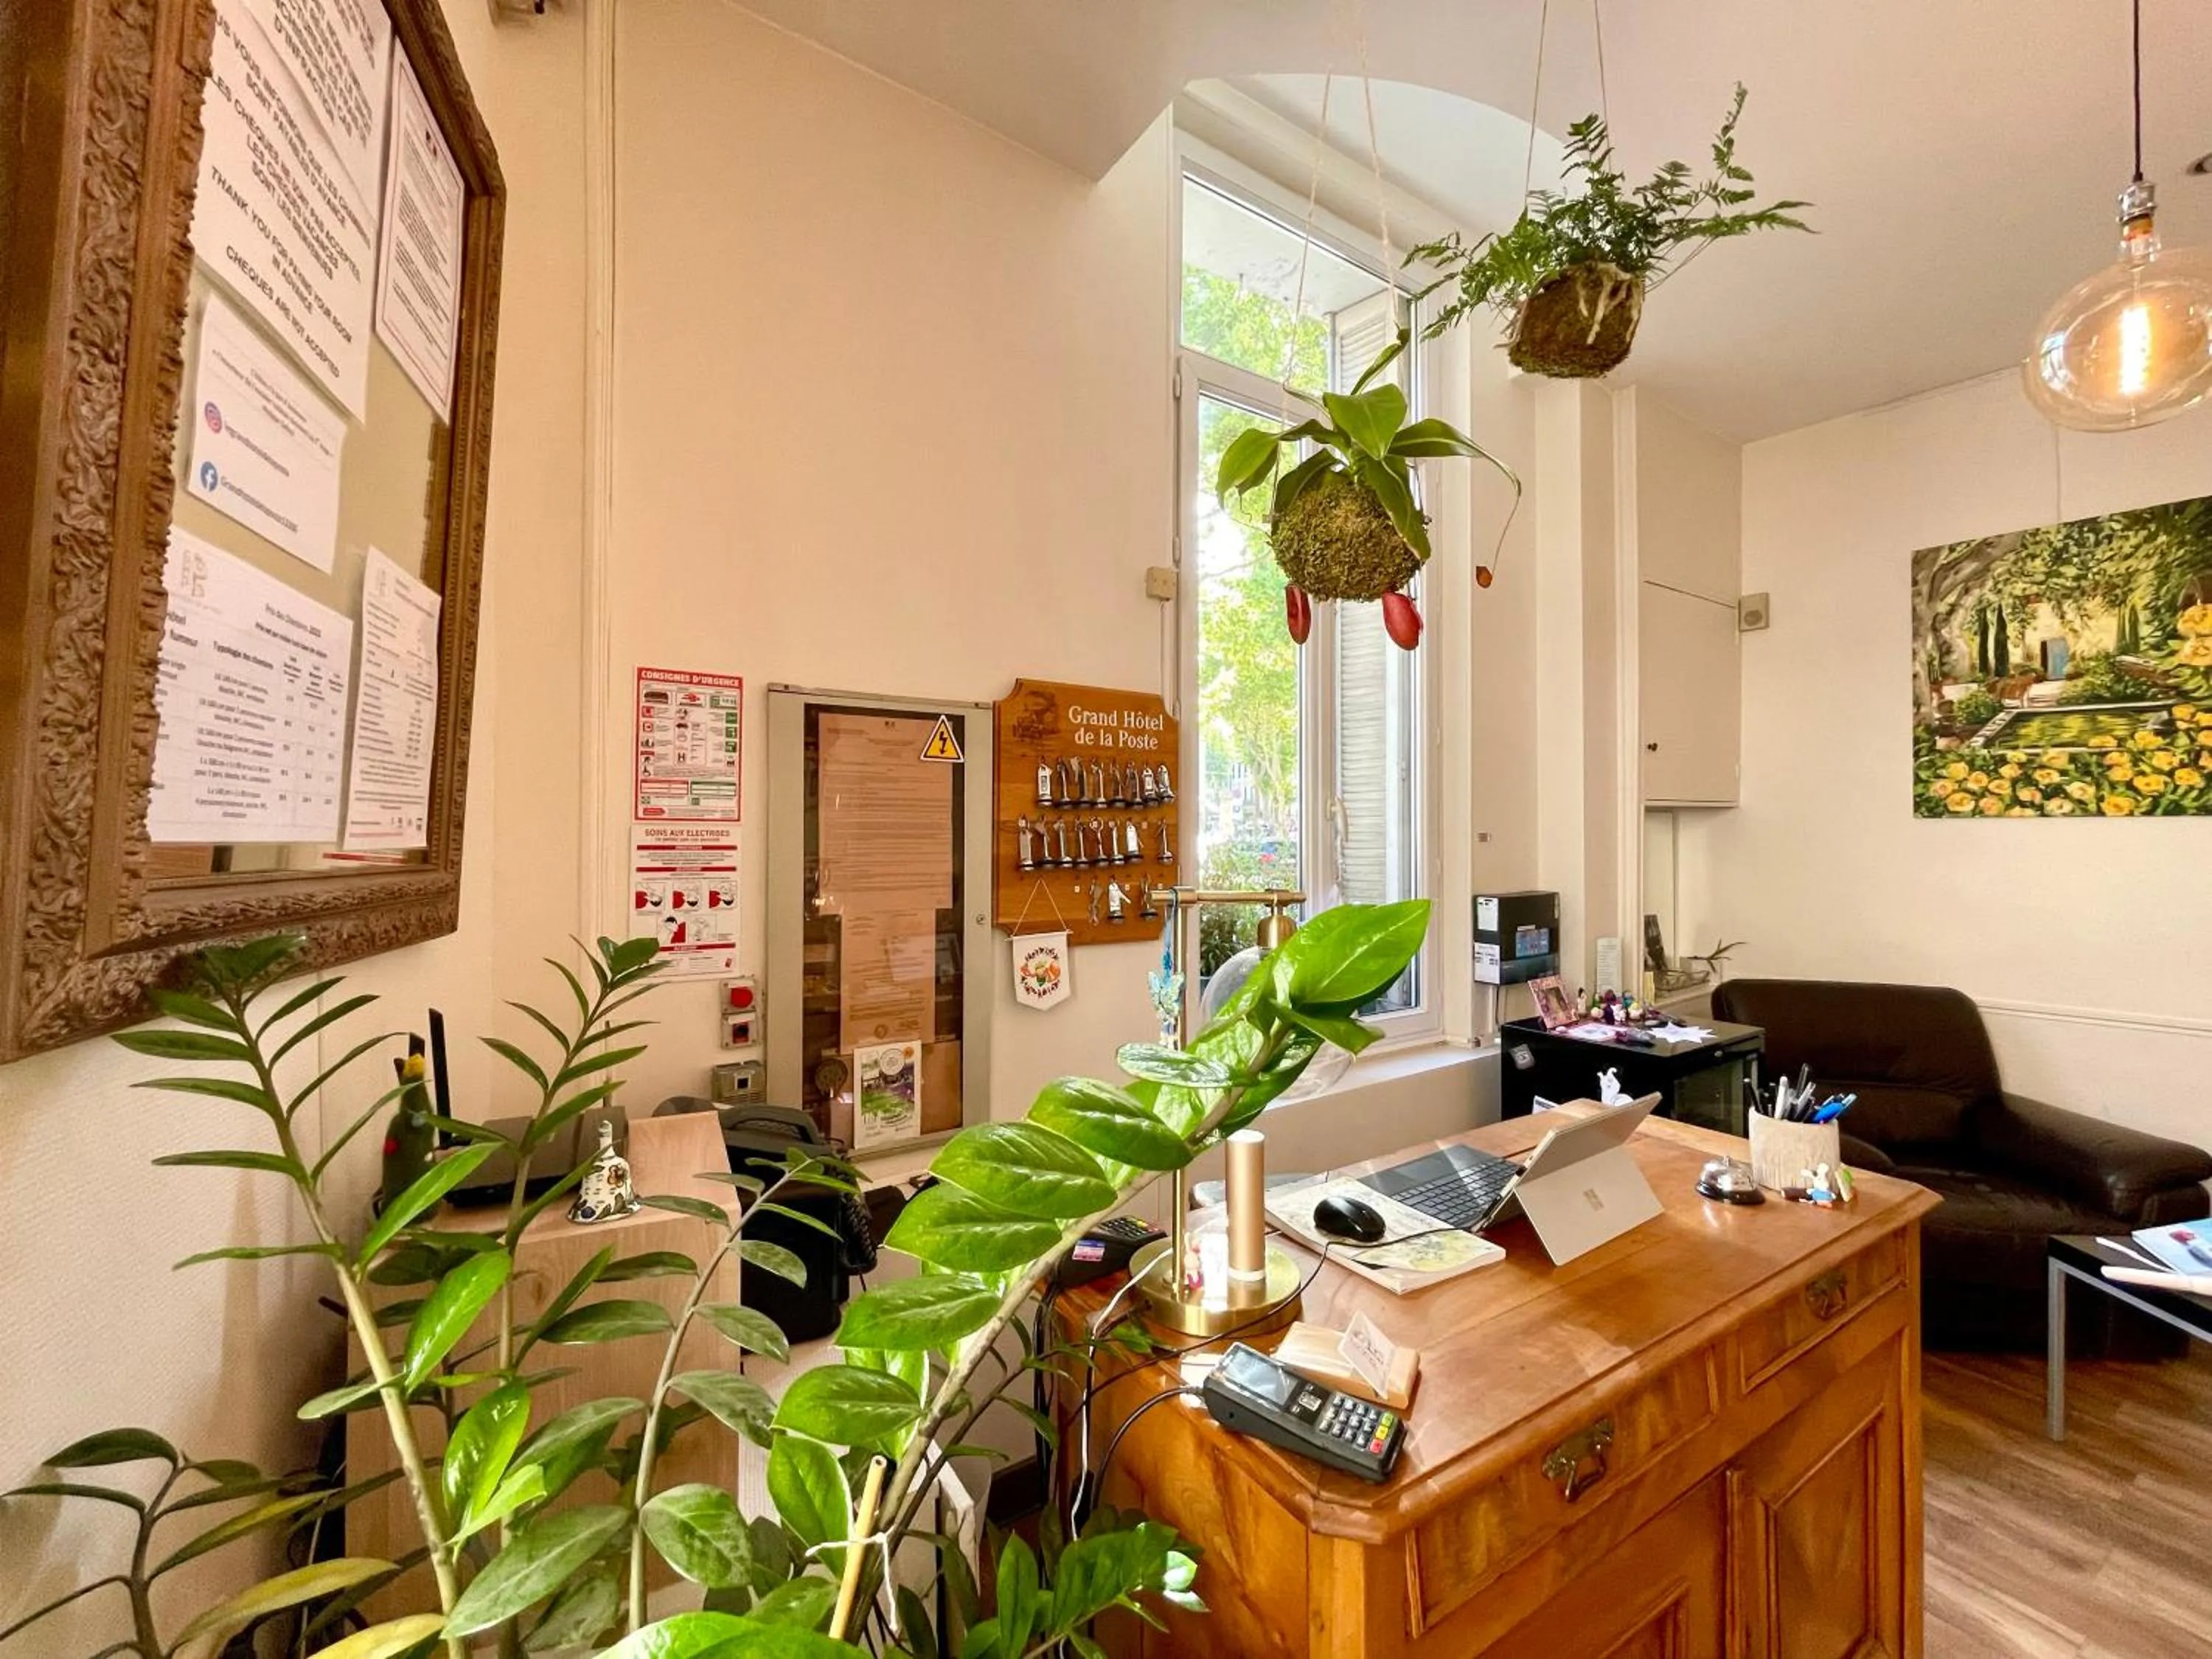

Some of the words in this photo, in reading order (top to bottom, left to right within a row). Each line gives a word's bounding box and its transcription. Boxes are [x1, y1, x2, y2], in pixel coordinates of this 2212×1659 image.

[232, 33, 260, 80] VOUS
[246, 71, 270, 112] SONT
[233, 95, 279, 164] CHEQUES
[246, 133, 265, 165] LES
[251, 160, 275, 196] SONT
[211, 166, 248, 215] THANK
[251, 209, 270, 240] YOU
[272, 234, 288, 261] FOR
[288, 256, 312, 296] PAYING
[314, 293, 330, 319] YOUR
[333, 316, 351, 344] ROOM
[272, 254, 280, 270] IN
[282, 266, 312, 313] ADVANCE
[226, 243, 274, 299] CHEQUES
[276, 295, 290, 319] ARE
[291, 316, 304, 336] NOT
[305, 333, 340, 379] ACCEPTED
[641, 669, 691, 682] CONSIGNES
[692, 675, 740, 686] D'URGENCE
[1068, 706, 1117, 726] Grand
[1124, 710, 1164, 731] Hôtel
[1074, 728, 1095, 745] de
[1099, 728, 1113, 747] la
[1119, 730, 1158, 750] Poste
[644, 828, 667, 837] SOINS
[669, 829, 685, 837] AUX
